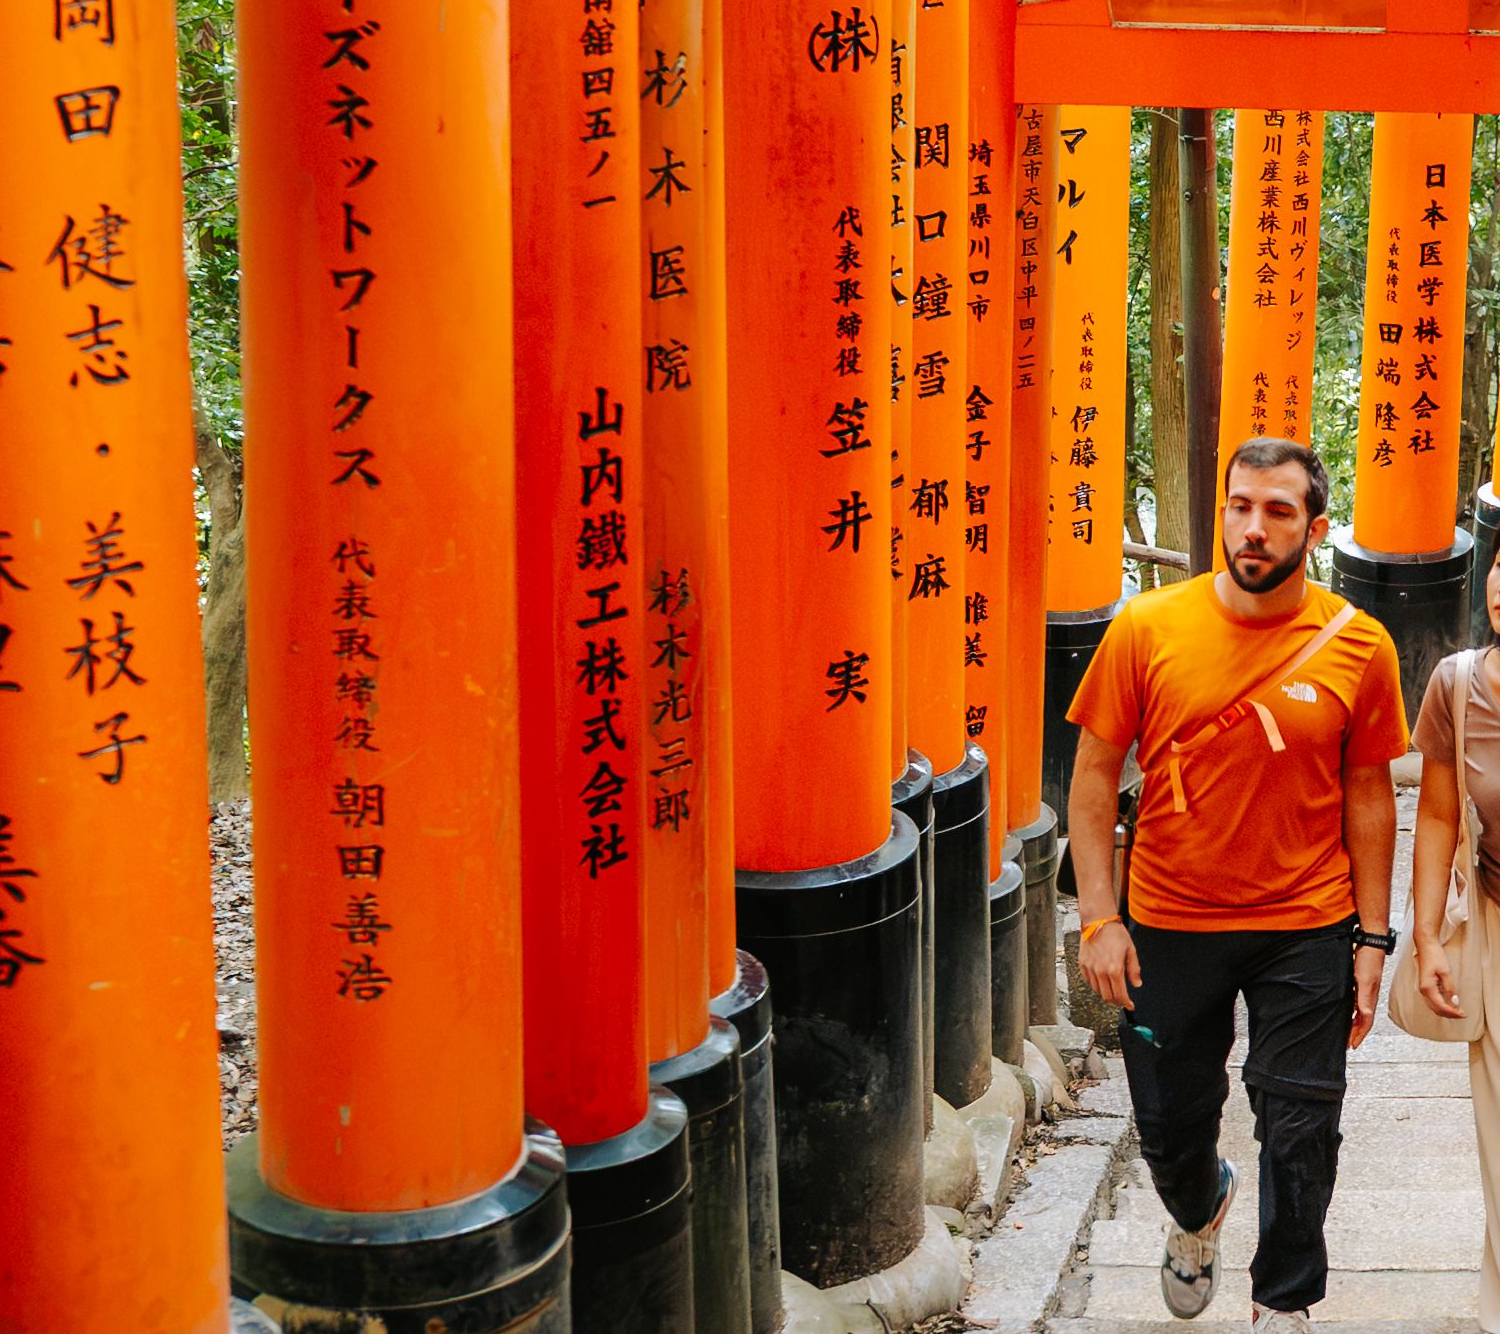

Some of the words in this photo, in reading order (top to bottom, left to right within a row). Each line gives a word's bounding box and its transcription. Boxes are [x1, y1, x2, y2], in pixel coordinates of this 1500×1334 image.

[641, 48, 692, 394] 杉木医院
[966, 139, 994, 322] 埼玉県川口市
[1056, 127, 1088, 265] マルイ
[1254, 109, 1285, 308] 西川産業株式会社
[832, 206, 864, 377] 代表取締役
[1408, 164, 1448, 454] 日本医学株式会社
[965, 384, 994, 555] 金子智明
[1069, 405, 1098, 545] 伊藤貴司
[1372, 323, 1404, 467] 田端隆彦
[333, 538, 379, 752] 代表取締役
[648, 568, 693, 833] 杉木光三郎
